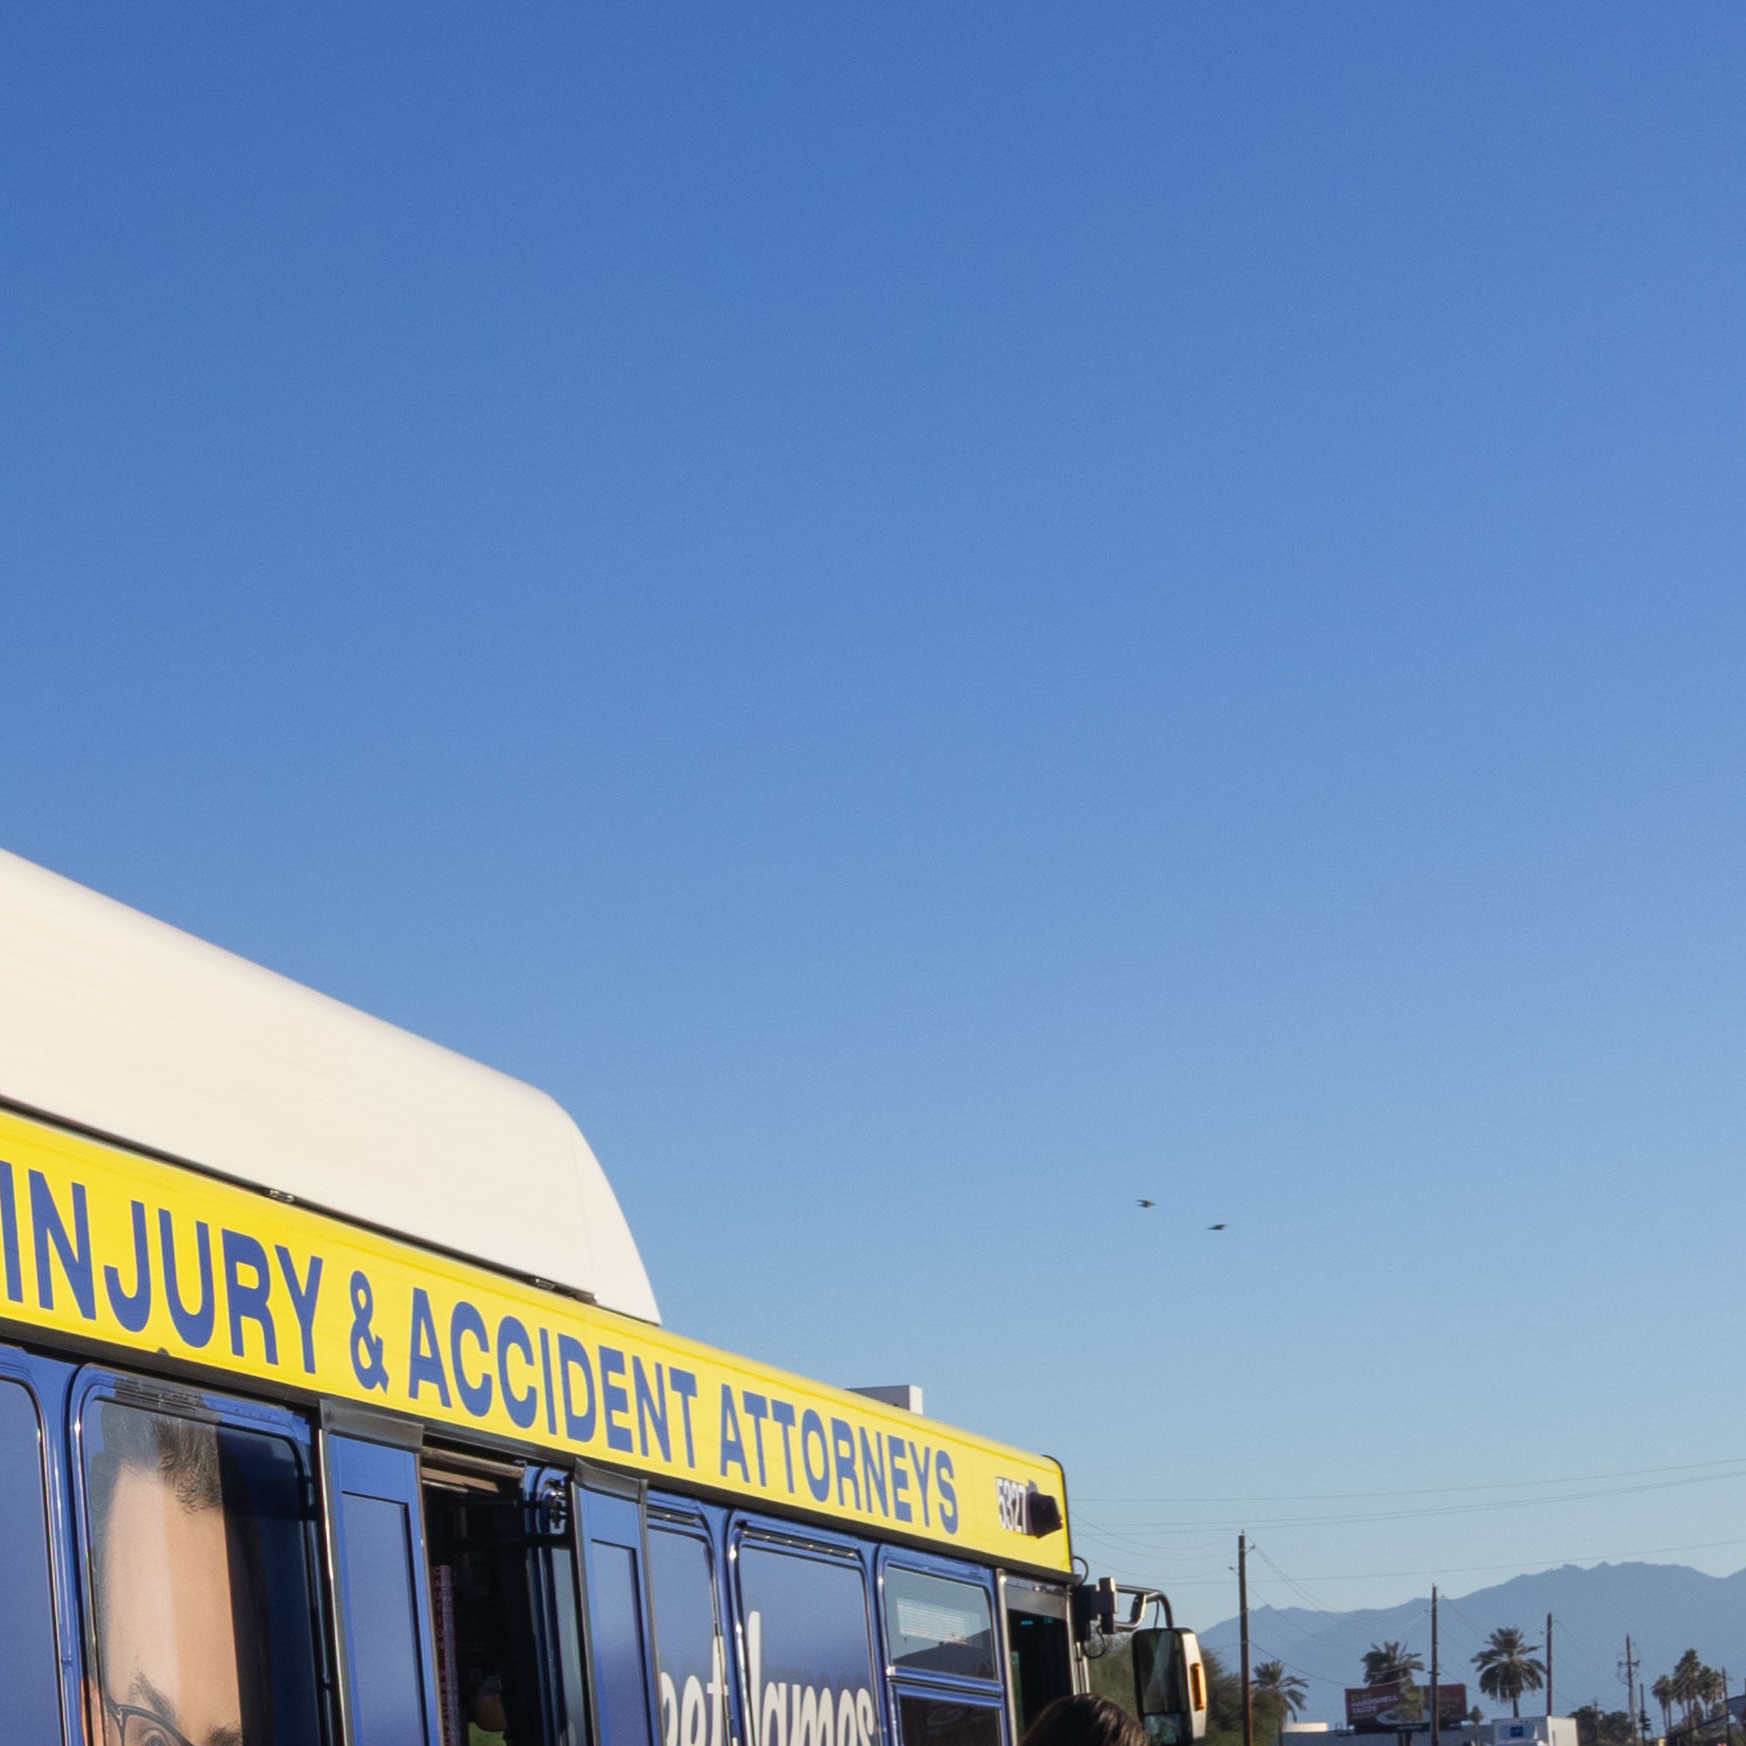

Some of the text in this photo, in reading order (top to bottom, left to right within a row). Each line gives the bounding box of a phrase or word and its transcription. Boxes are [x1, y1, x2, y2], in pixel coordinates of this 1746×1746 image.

[348, 1269, 391, 1392] &
[407, 1286, 698, 1470] ACCIDENT
[717, 1391, 959, 1535] ATTORNEYS
[996, 1478, 1027, 1535] 5327
